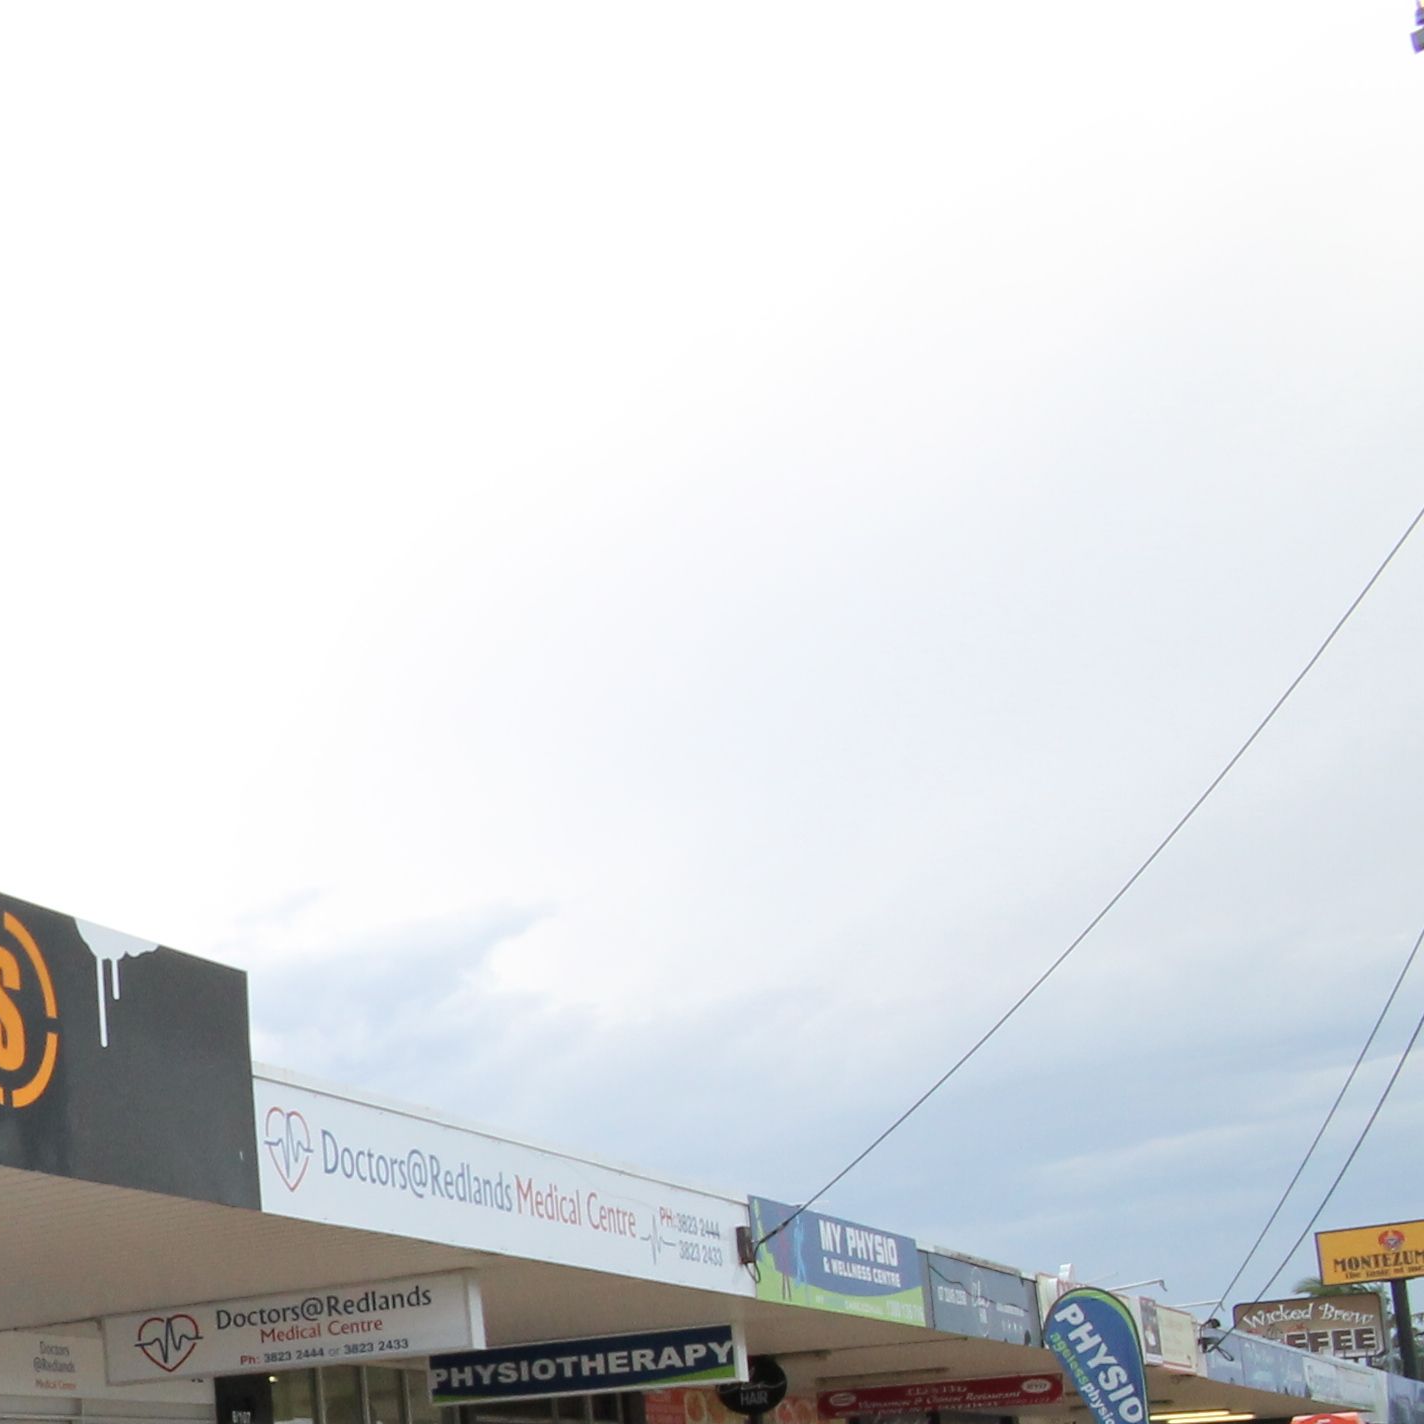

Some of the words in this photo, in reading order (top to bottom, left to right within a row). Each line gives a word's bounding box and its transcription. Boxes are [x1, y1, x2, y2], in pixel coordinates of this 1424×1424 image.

[321, 1128, 512, 1213] Doctors@Redlands
[515, 1175, 582, 1227] Medical
[587, 1192, 636, 1238] Centre
[676, 1214, 698, 1236] 3823
[699, 1217, 721, 1239] 2444
[678, 1240, 701, 1263] 3823
[702, 1242, 723, 1267] 2433
[819, 1219, 842, 1254] MY
[846, 1227, 898, 1267] PHYSIO
[831, 1258, 872, 1282] WELLNESS
[873, 1265, 902, 1288] CENTRE
[216, 1285, 433, 1331] Doctors@Redlands
[1242, 1302, 1314, 1329] Wicked
[1318, 1303, 1375, 1325] Brew
[260, 1324, 321, 1344] Medical
[327, 1317, 384, 1336] Centre
[240, 1353, 260, 1366] Ph:
[263, 1351, 292, 1364] 3823
[296, 1347, 325, 1360] 2444
[343, 1343, 374, 1356] 3823
[378, 1338, 409, 1351] 2433
[431, 1340, 734, 1390] PHYSIOTHERAPY
[1055, 1303, 1143, 1424] PHYSIO
